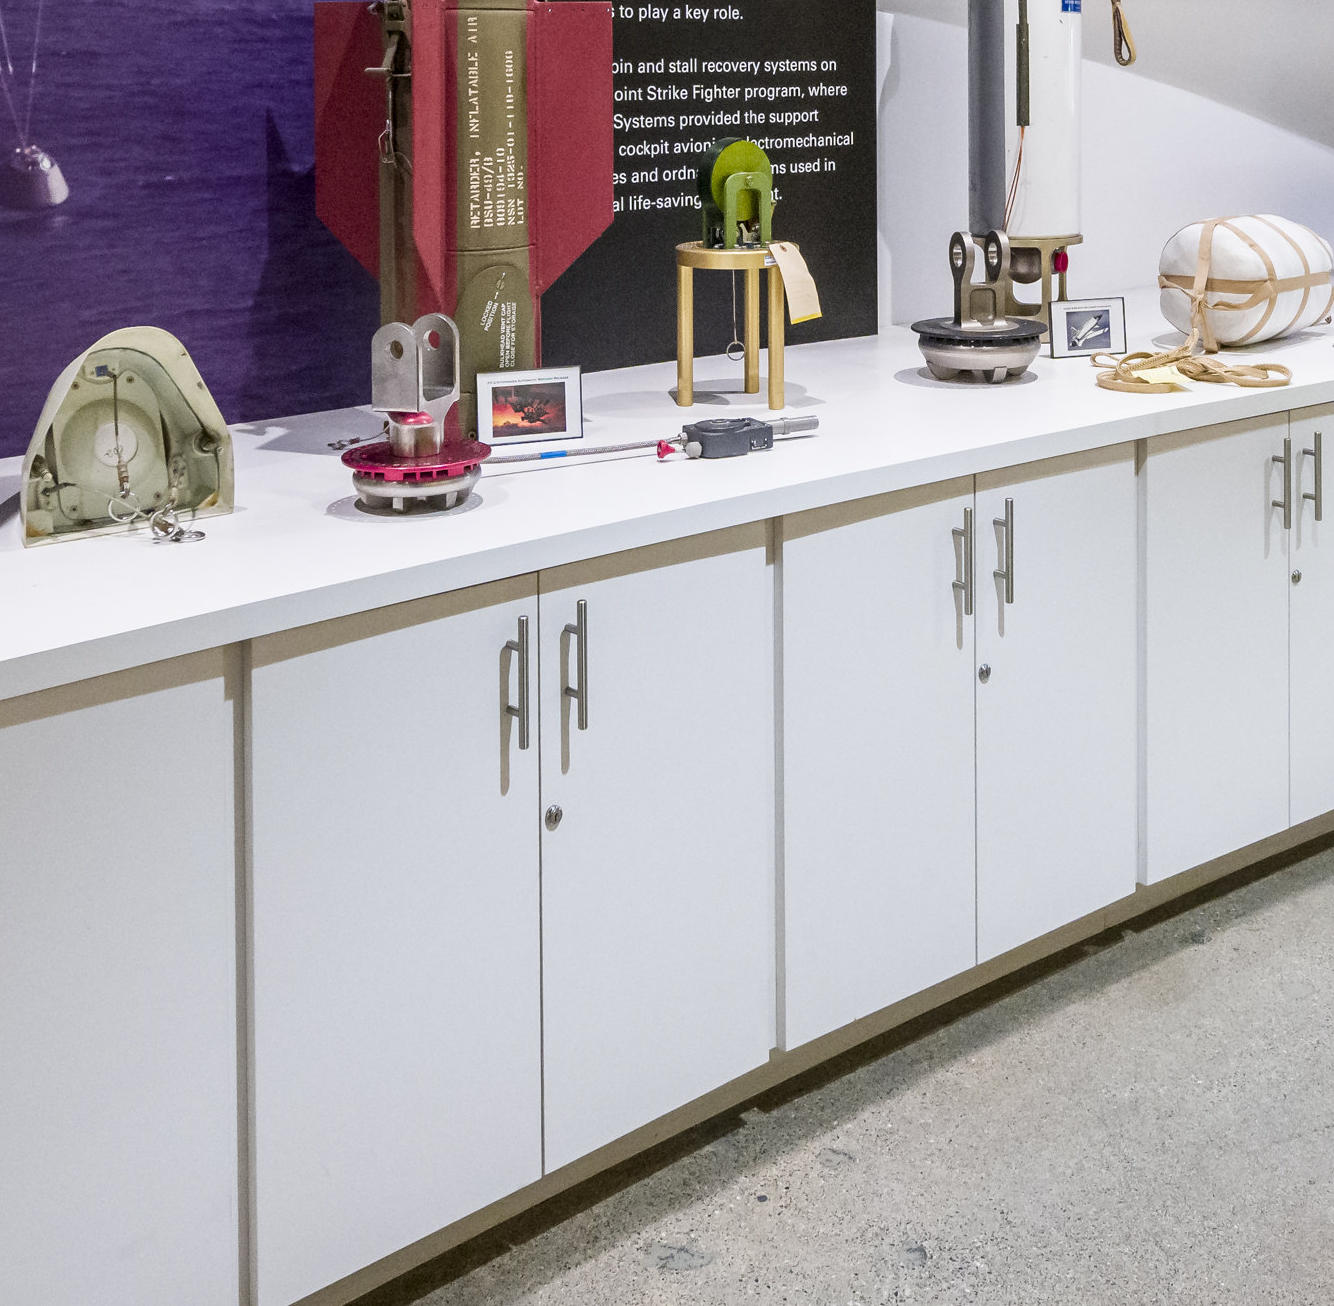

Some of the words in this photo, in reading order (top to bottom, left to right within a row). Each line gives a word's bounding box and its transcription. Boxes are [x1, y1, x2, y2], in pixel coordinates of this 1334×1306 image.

[619, 5, 633, 18] to
[639, 4, 668, 22] play
[673, 8, 680, 19] a
[686, 5, 709, 22] key
[714, 5, 743, 19] role.
[467, 17, 477, 43] AIR
[638, 59, 664, 73] and
[669, 58, 697, 73] stall
[703, 62, 760, 75] recovery
[764, 59, 817, 74] systems
[821, 61, 836, 71] on
[468, 52, 479, 138] INFLATABLE
[615, 86, 643, 101] oint
[647, 85, 688, 100] Strike
[693, 85, 740, 102] Fighter
[745, 87, 804, 101] program,
[808, 83, 847, 96] where
[614, 114, 675, 132] Systems
[680, 111, 740, 130] provided
[744, 110, 765, 124] the
[769, 110, 818, 125] support
[619, 140, 669, 158] cockpit
[631, 167, 658, 183] and
[790, 158, 820, 173] used
[825, 158, 835, 171] in
[469, 151, 481, 228] RETARDER,
[481, 156, 495, 227] BSU-49/B
[630, 193, 701, 210] life-saving
[507, 198, 516, 226] NSN
[480, 300, 492, 325] LOCKED
[484, 302, 498, 332] POSITION
